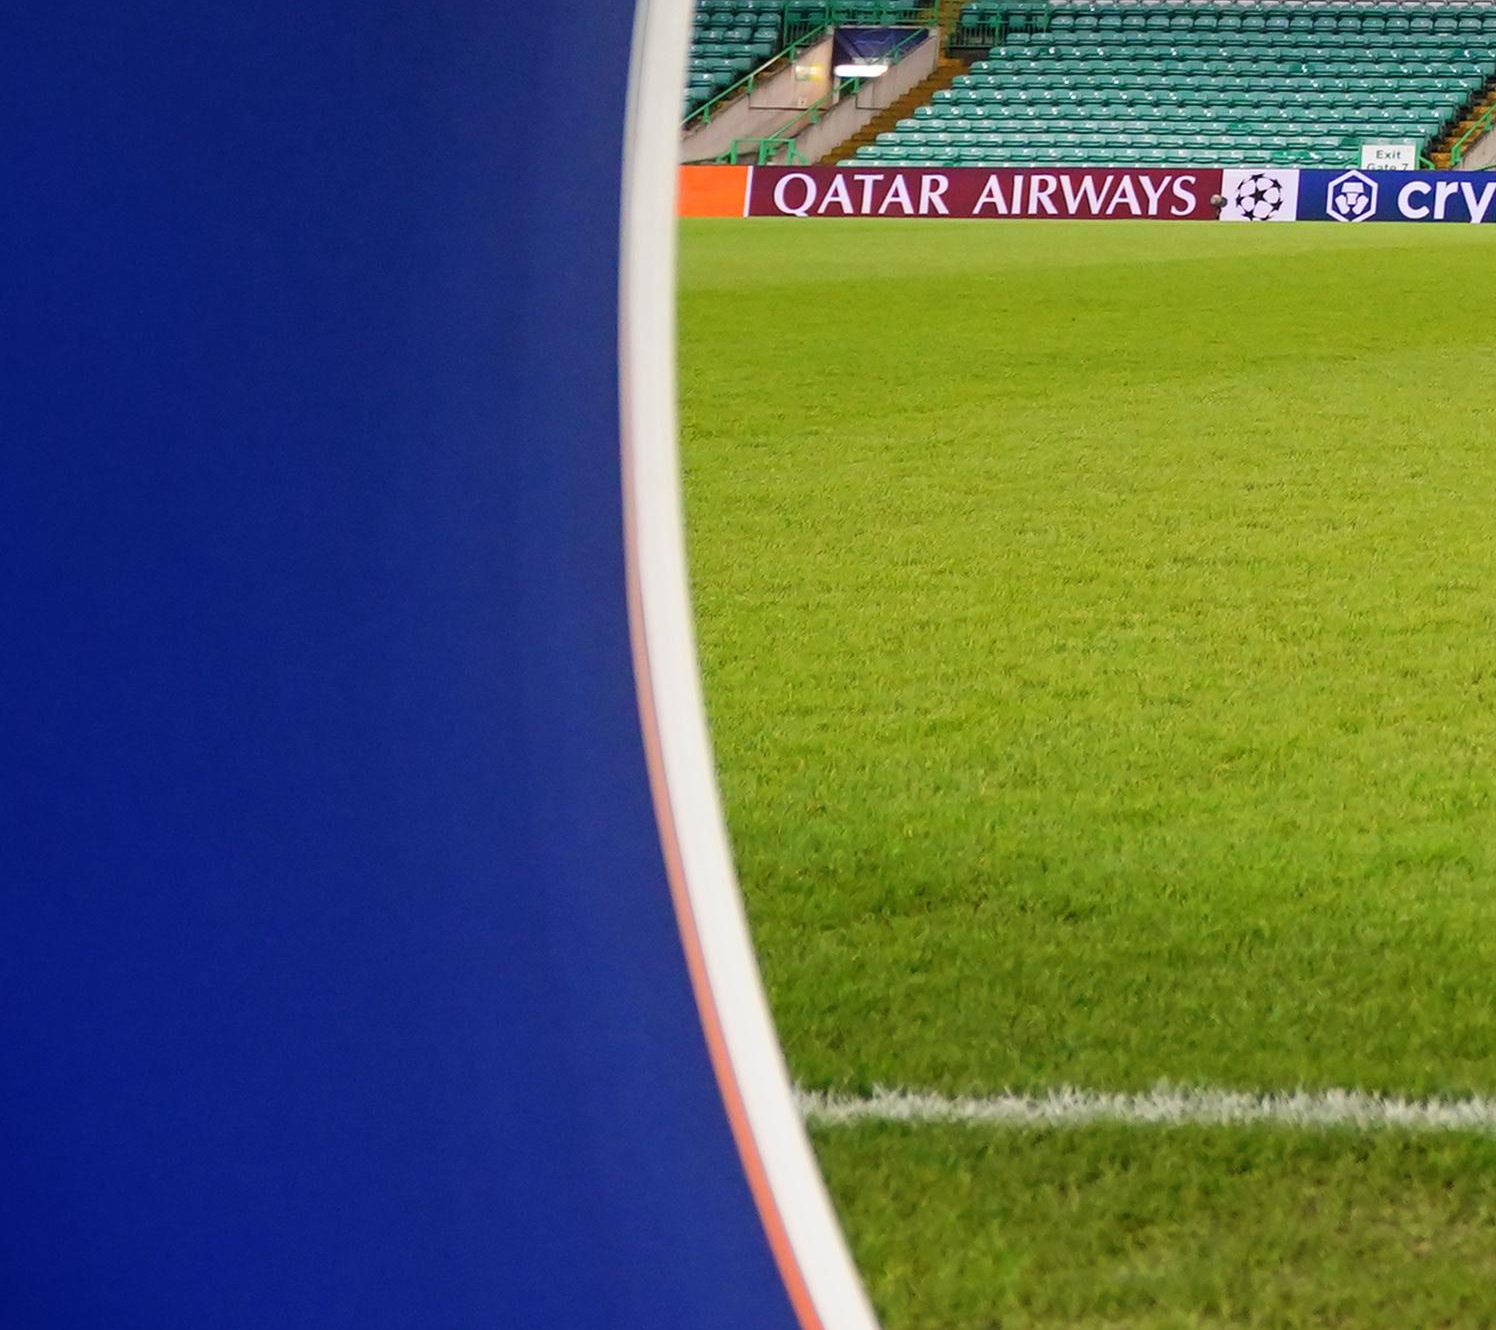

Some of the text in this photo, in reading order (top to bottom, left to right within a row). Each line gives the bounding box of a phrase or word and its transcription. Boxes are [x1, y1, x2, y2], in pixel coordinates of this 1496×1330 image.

[1375, 150, 1402, 160] Exit
[1366, 163, 1409, 171] Gate 7
[773, 172, 1197, 218] QATAR AIRWAYS
